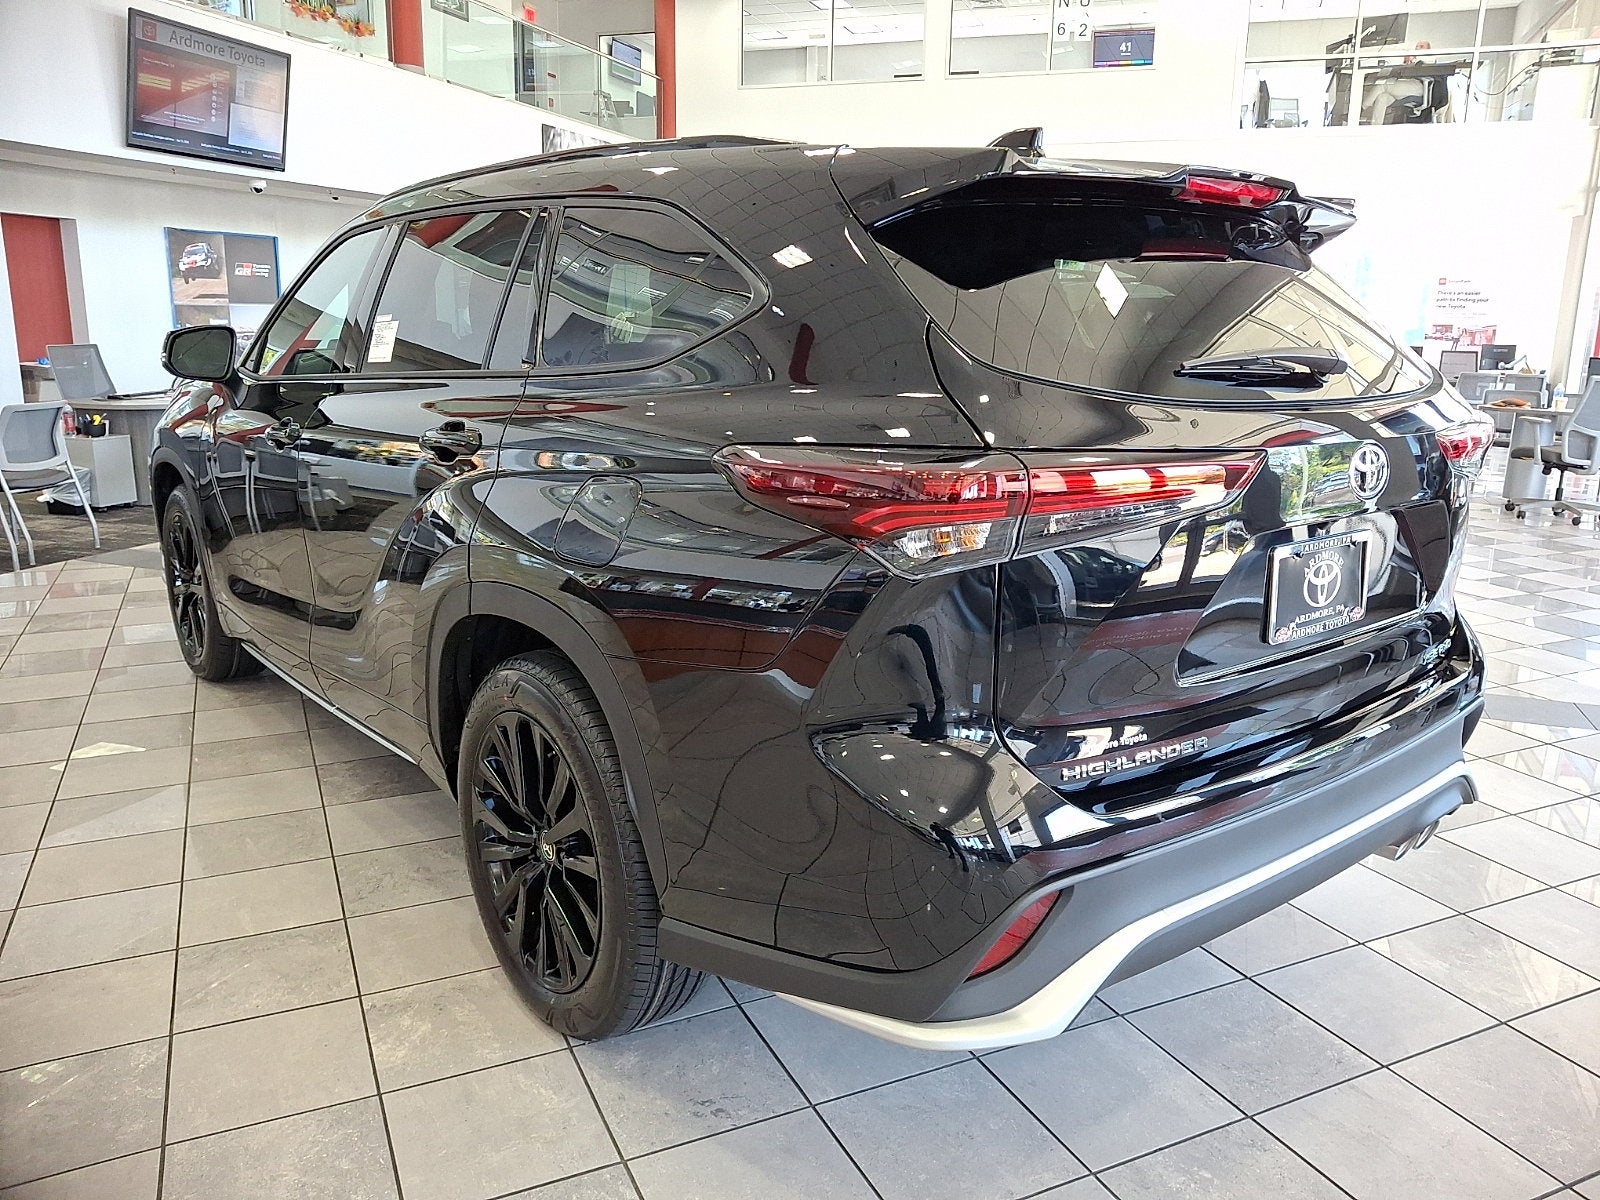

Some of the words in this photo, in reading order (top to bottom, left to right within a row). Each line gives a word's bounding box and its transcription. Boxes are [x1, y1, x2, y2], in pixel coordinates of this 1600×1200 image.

[169, 29, 225, 57] Ardmore
[228, 45, 266, 68] Toyota
[1119, 41, 1132, 53] 41
[1303, 550, 1345, 578] ARDMORE
[1294, 606, 1335, 625] ARDMORE,
[1336, 603, 1345, 616] PA
[1291, 623, 1324, 640] ARDMORE
[1325, 615, 1350, 631] TOYOTA
[1119, 733, 1148, 746] Toyota
[1061, 736, 1209, 781] HIGHLANDER
